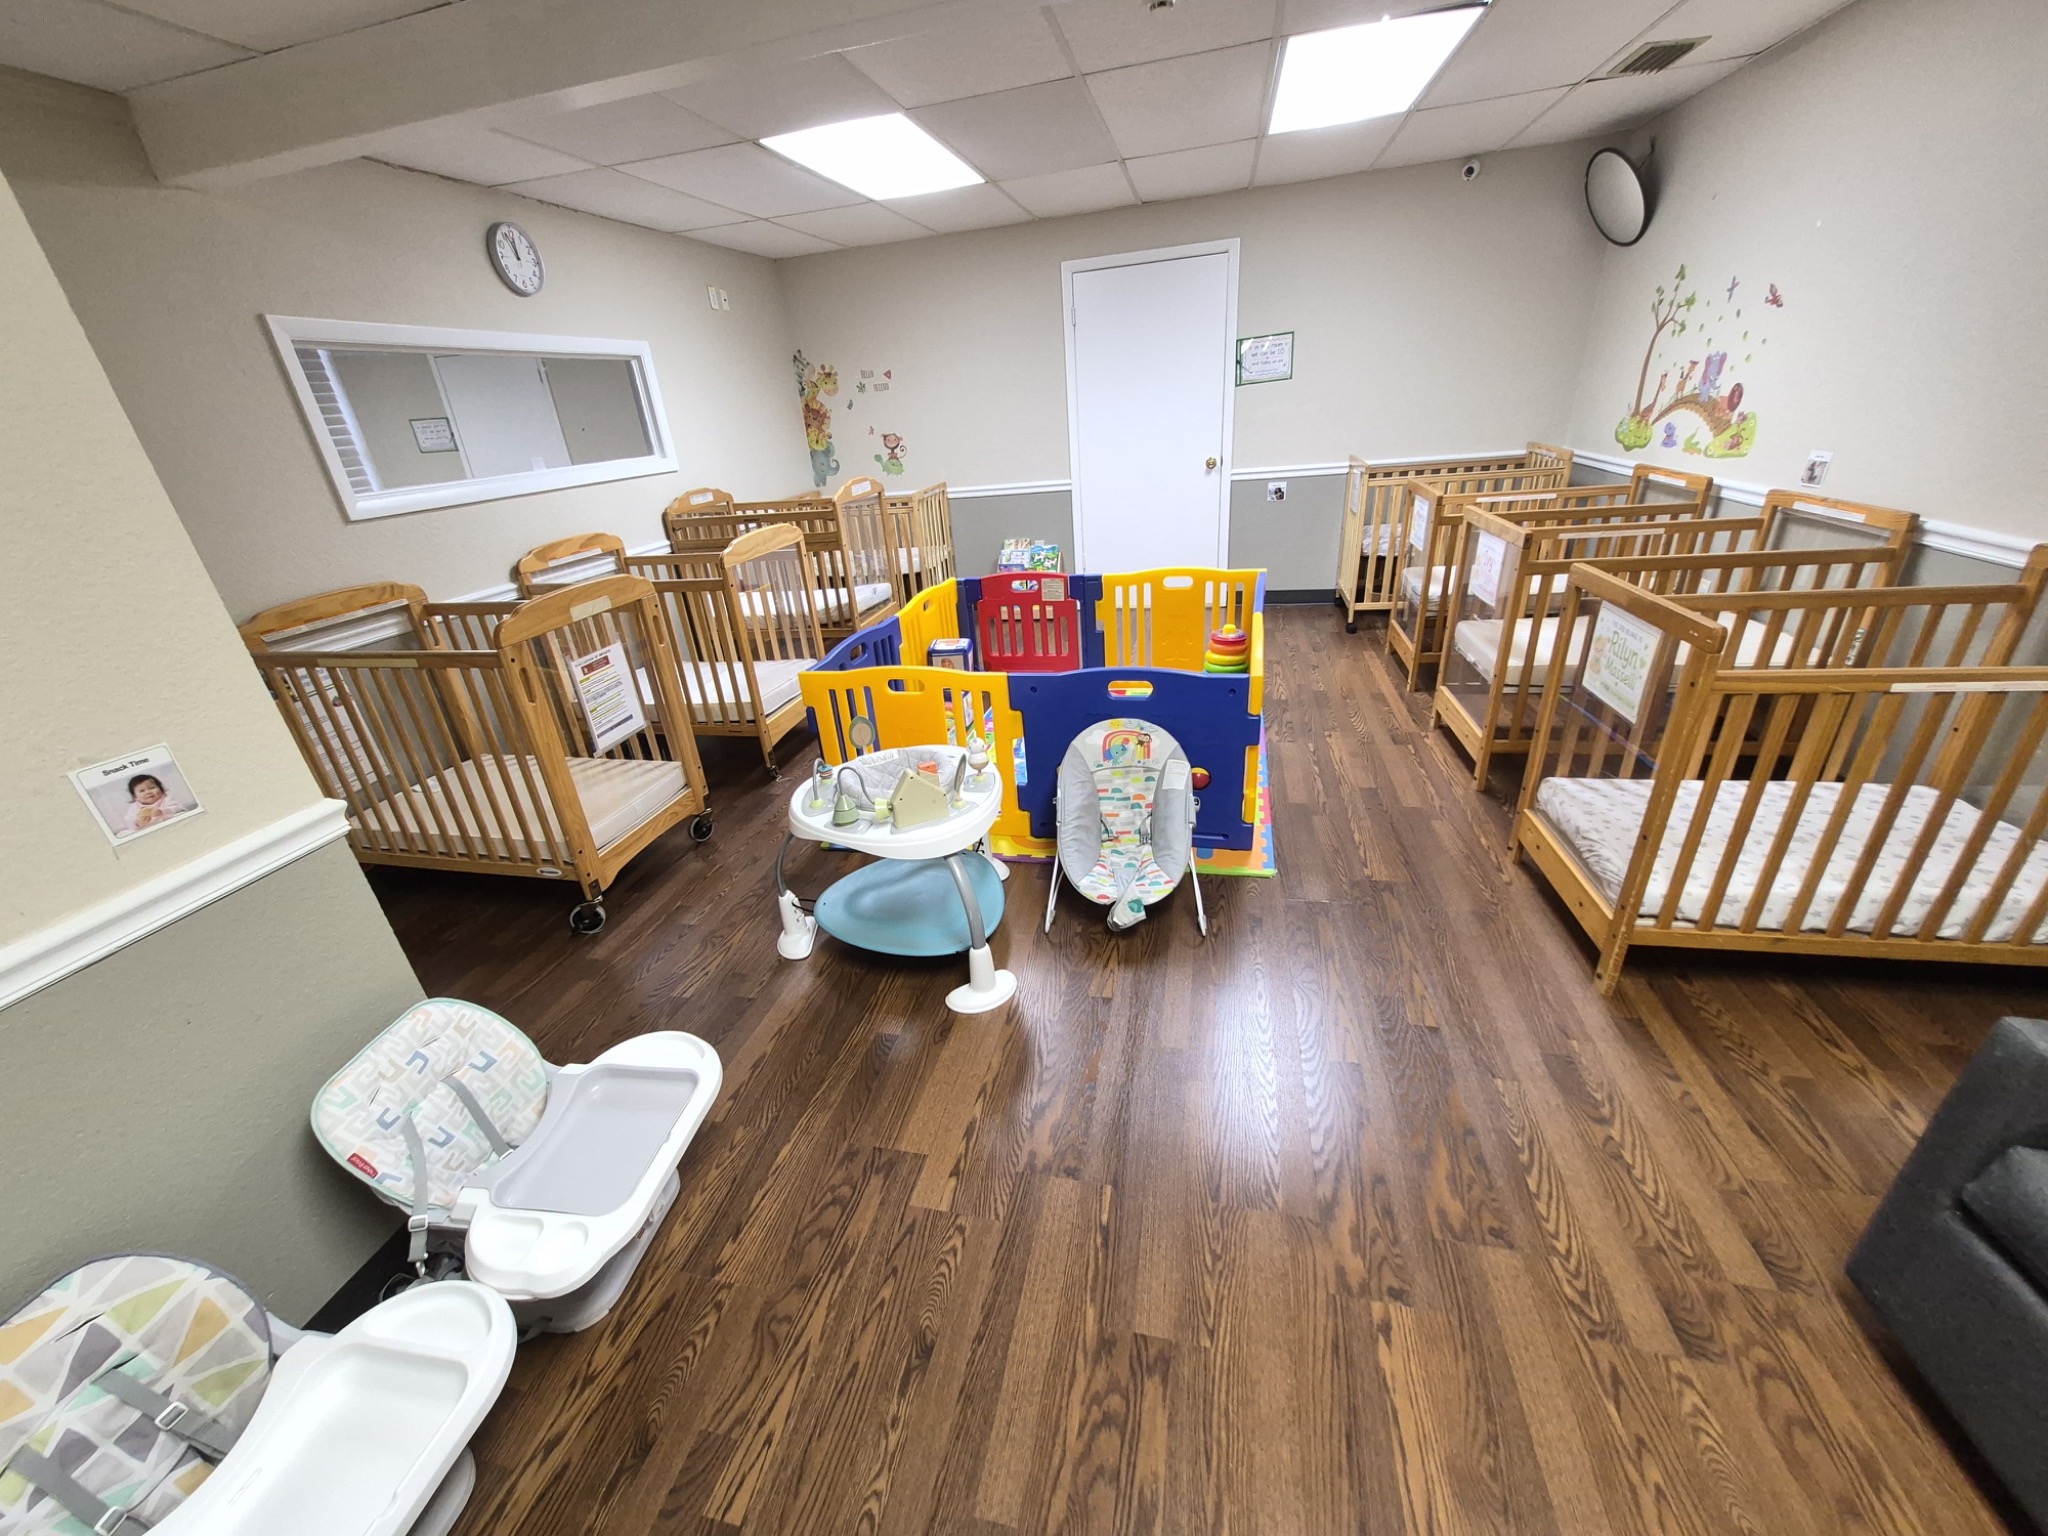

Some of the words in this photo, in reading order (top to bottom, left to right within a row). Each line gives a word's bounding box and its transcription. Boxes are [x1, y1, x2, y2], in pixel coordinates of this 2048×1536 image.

[1608, 630, 1639, 670] Rilyn
[102, 763, 129, 776] Snack
[129, 758, 150, 768] Time
